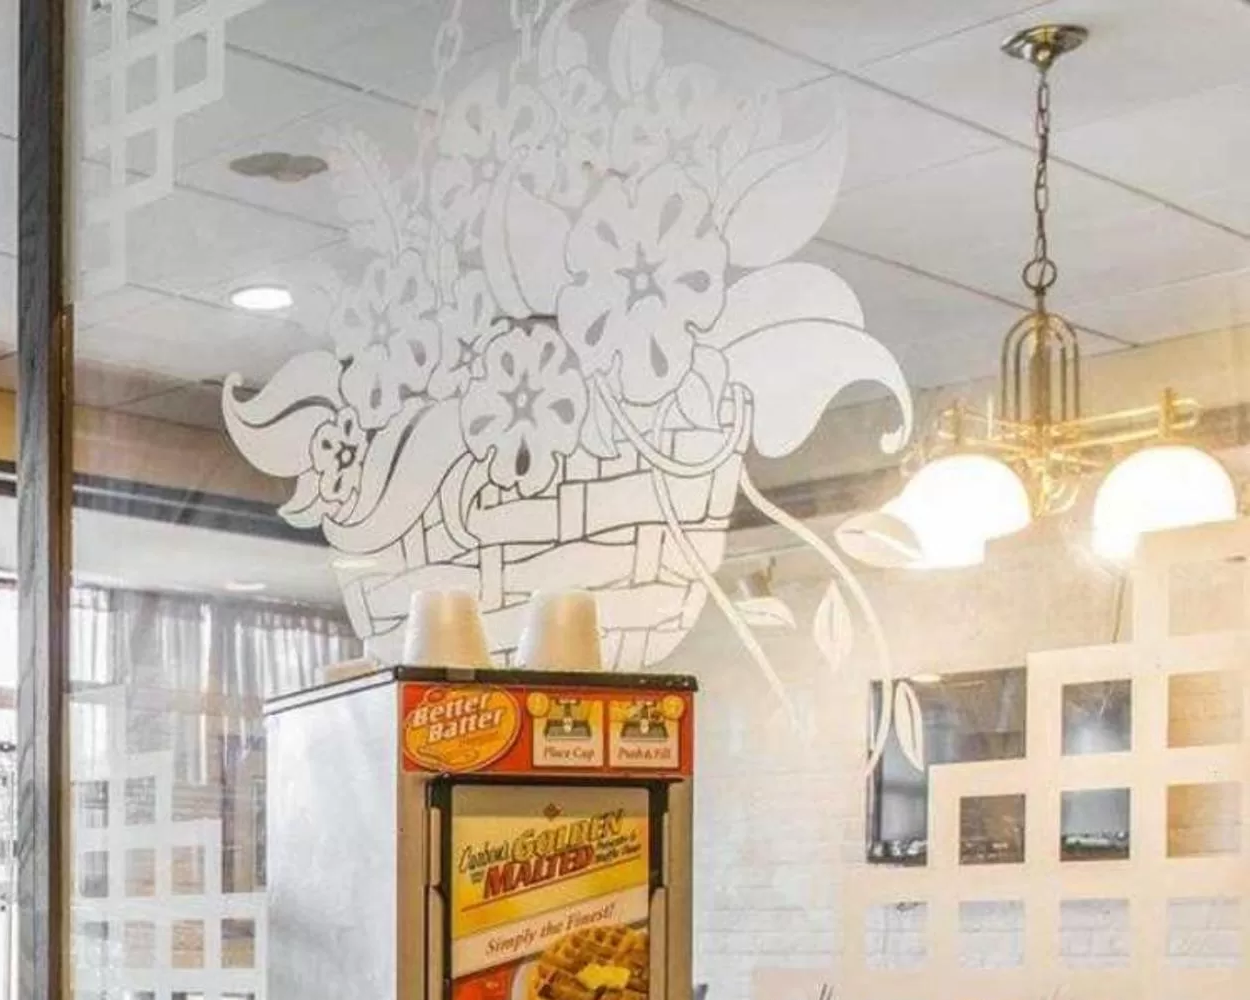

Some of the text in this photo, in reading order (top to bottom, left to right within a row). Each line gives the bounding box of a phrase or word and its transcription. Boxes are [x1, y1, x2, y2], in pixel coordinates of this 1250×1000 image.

[411, 692, 490, 728] Better
[428, 708, 503, 743] Batter
[511, 807, 624, 863] GOLDEN
[483, 843, 596, 899] MALTED
[485, 927, 537, 956] Simply
[540, 919, 564, 938] the
